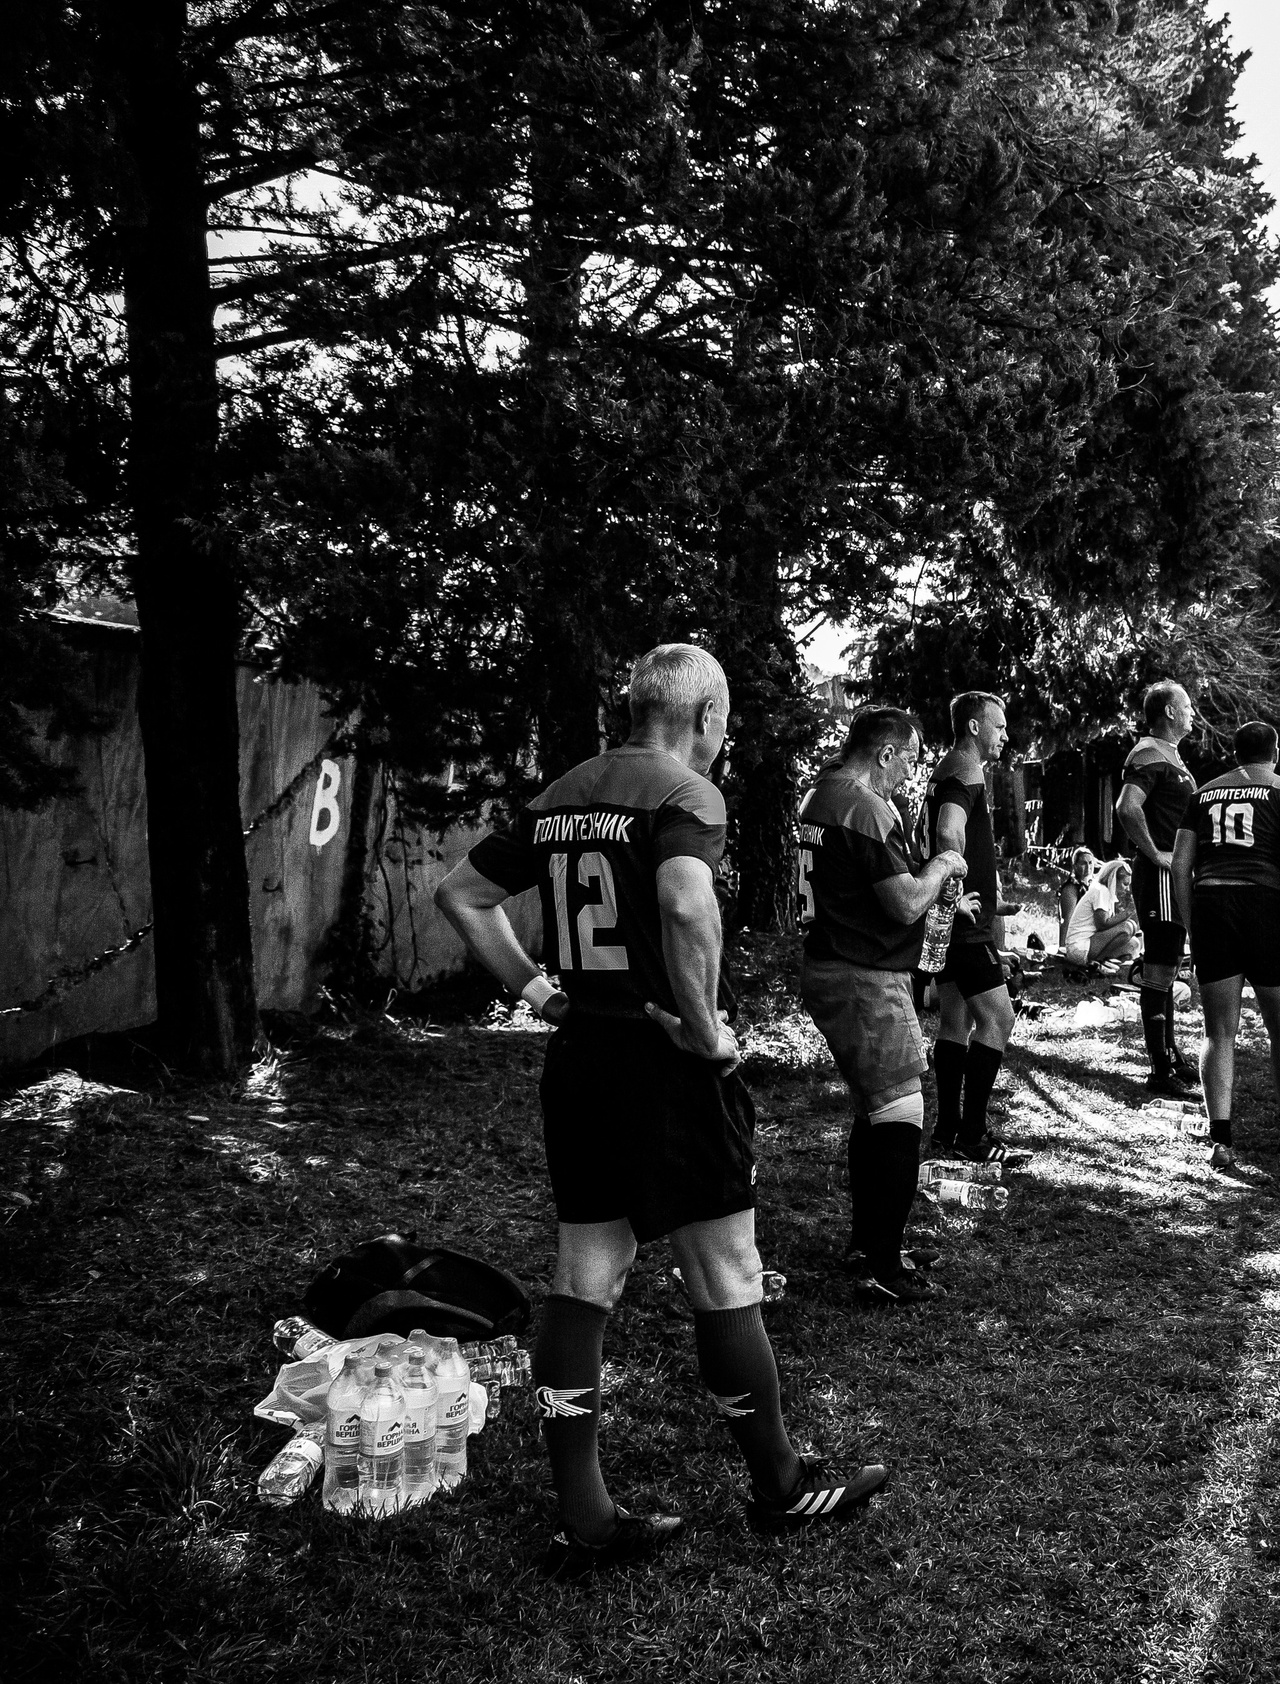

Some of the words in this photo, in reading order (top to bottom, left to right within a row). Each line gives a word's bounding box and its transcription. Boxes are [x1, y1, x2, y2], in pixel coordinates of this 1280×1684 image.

[1199, 787, 1270, 804] ПОЛИТЕХНИК
[533, 812, 635, 844] ПОЛИТЕХНИК
[1208, 803, 1254, 847] 10
[549, 852, 629, 970] 12
